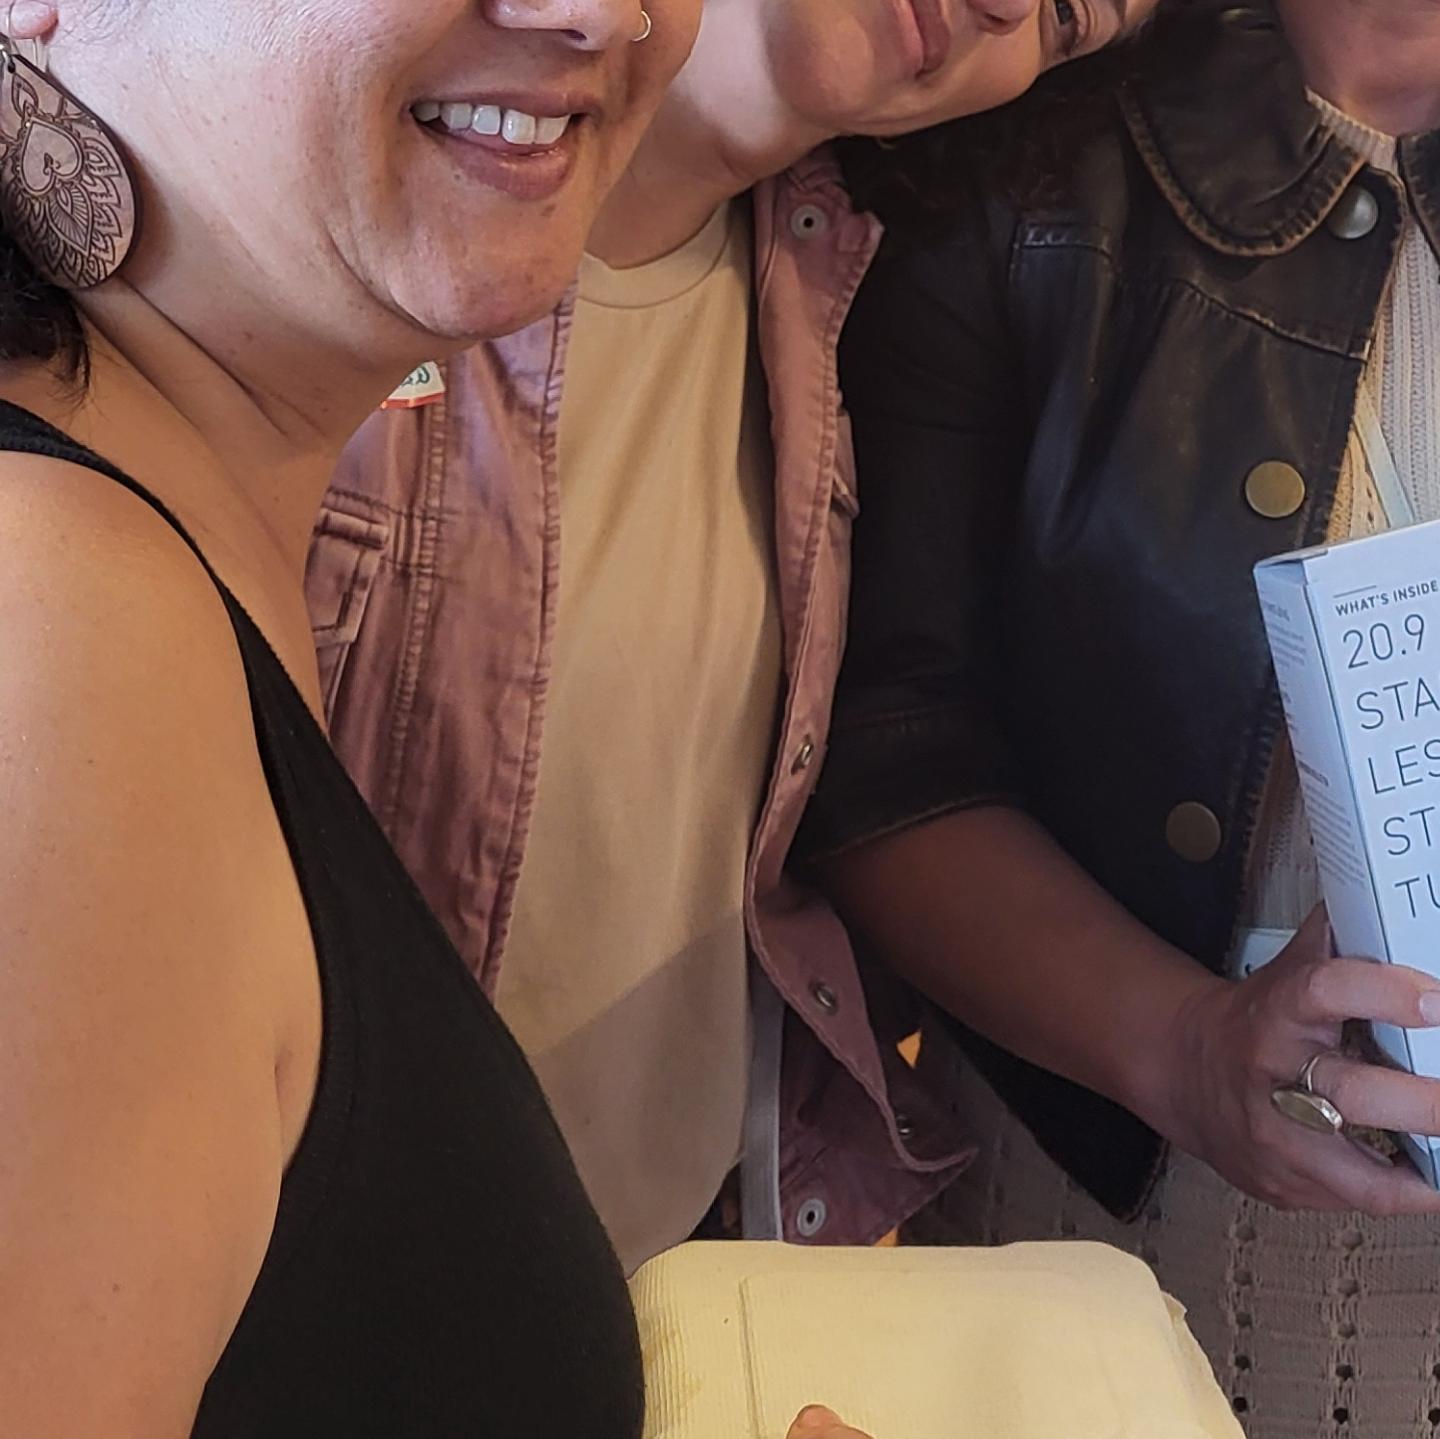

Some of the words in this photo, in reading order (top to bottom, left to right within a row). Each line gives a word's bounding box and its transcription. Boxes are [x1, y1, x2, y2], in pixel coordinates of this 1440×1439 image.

[1334, 593, 1390, 617] WHAT'S
[1393, 579, 1439, 602] INSIDE
[1342, 613, 1425, 669] 20.9
